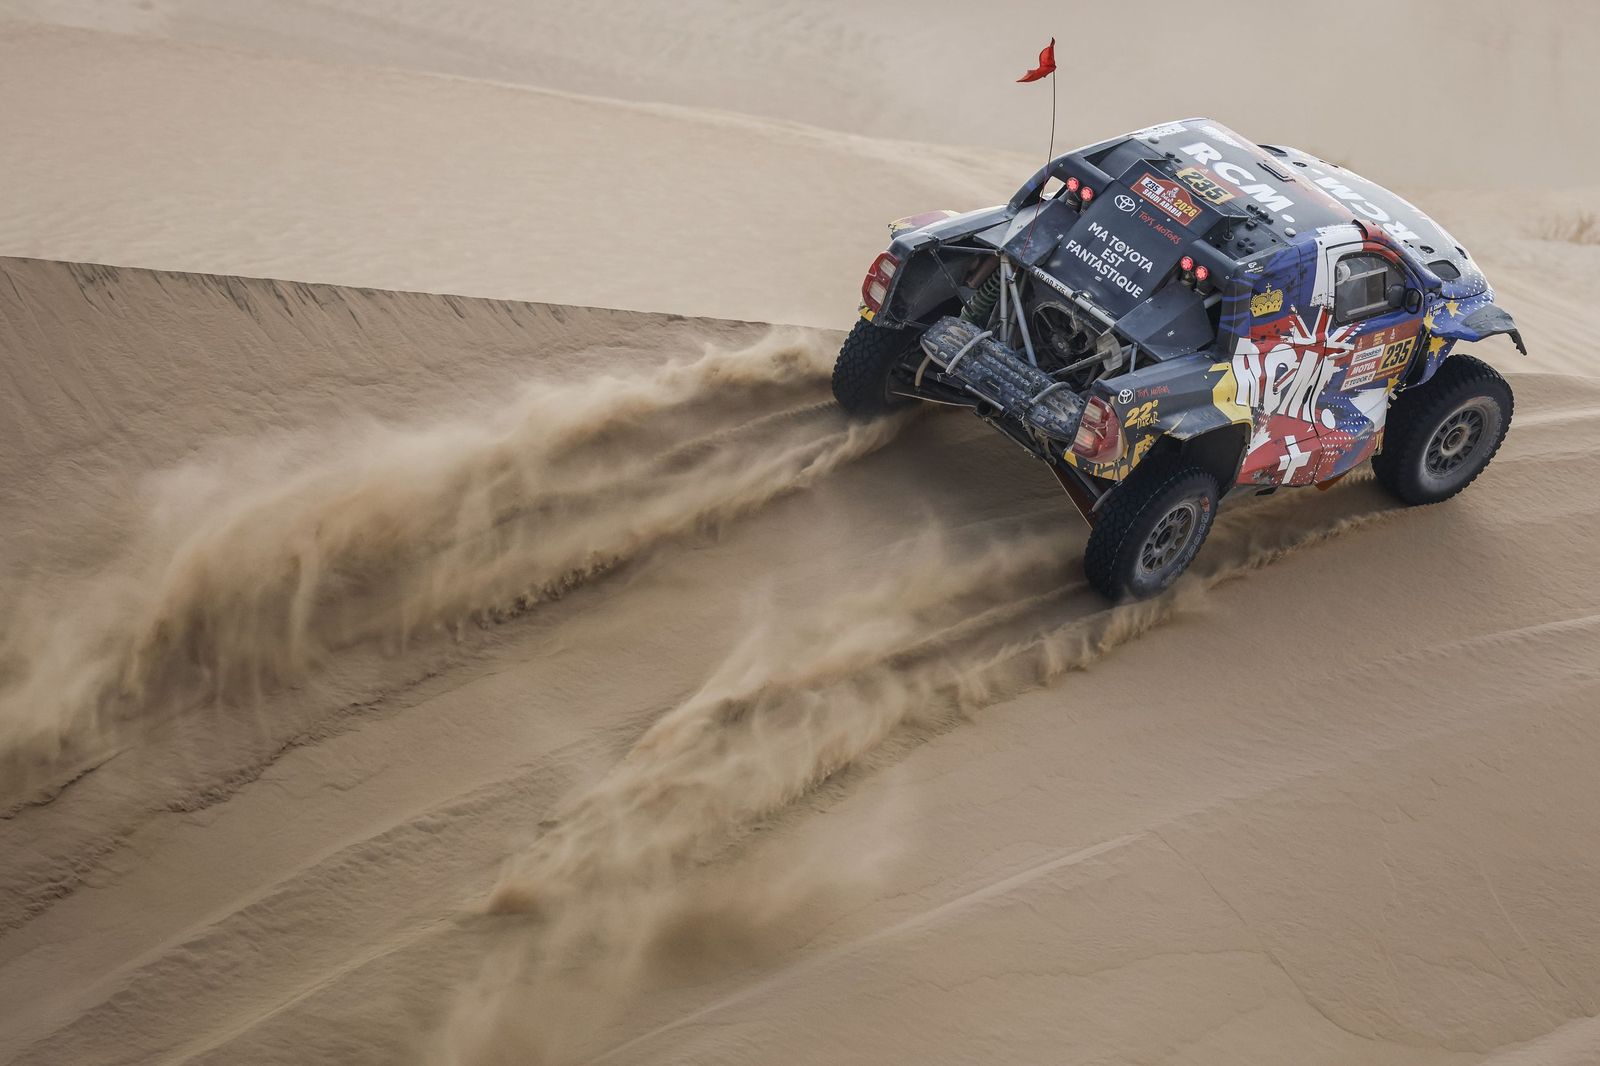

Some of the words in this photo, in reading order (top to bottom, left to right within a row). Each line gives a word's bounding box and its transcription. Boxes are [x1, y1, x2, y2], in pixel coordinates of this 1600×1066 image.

[1144, 180, 1160, 192] 235
[1180, 142, 1295, 222] RCM.
[1182, 171, 1228, 200] 235
[1142, 188, 1161, 205] SAUDI
[1160, 200, 1182, 218] ARABIA
[1174, 199, 1197, 217] 2026
[1139, 211, 1154, 226] TOYS
[1154, 224, 1182, 245] MOTORS
[1088, 222, 1109, 242] MA
[1109, 235, 1153, 273] TOYOTA
[1101, 248, 1125, 267] EST
[1066, 240, 1143, 298] FANTASTIQUE
[1350, 361, 1376, 376] MOTUL
[1381, 339, 1412, 370] 235
[1349, 376, 1368, 386] TUDOR
[1137, 411, 1160, 430] DAKAR
